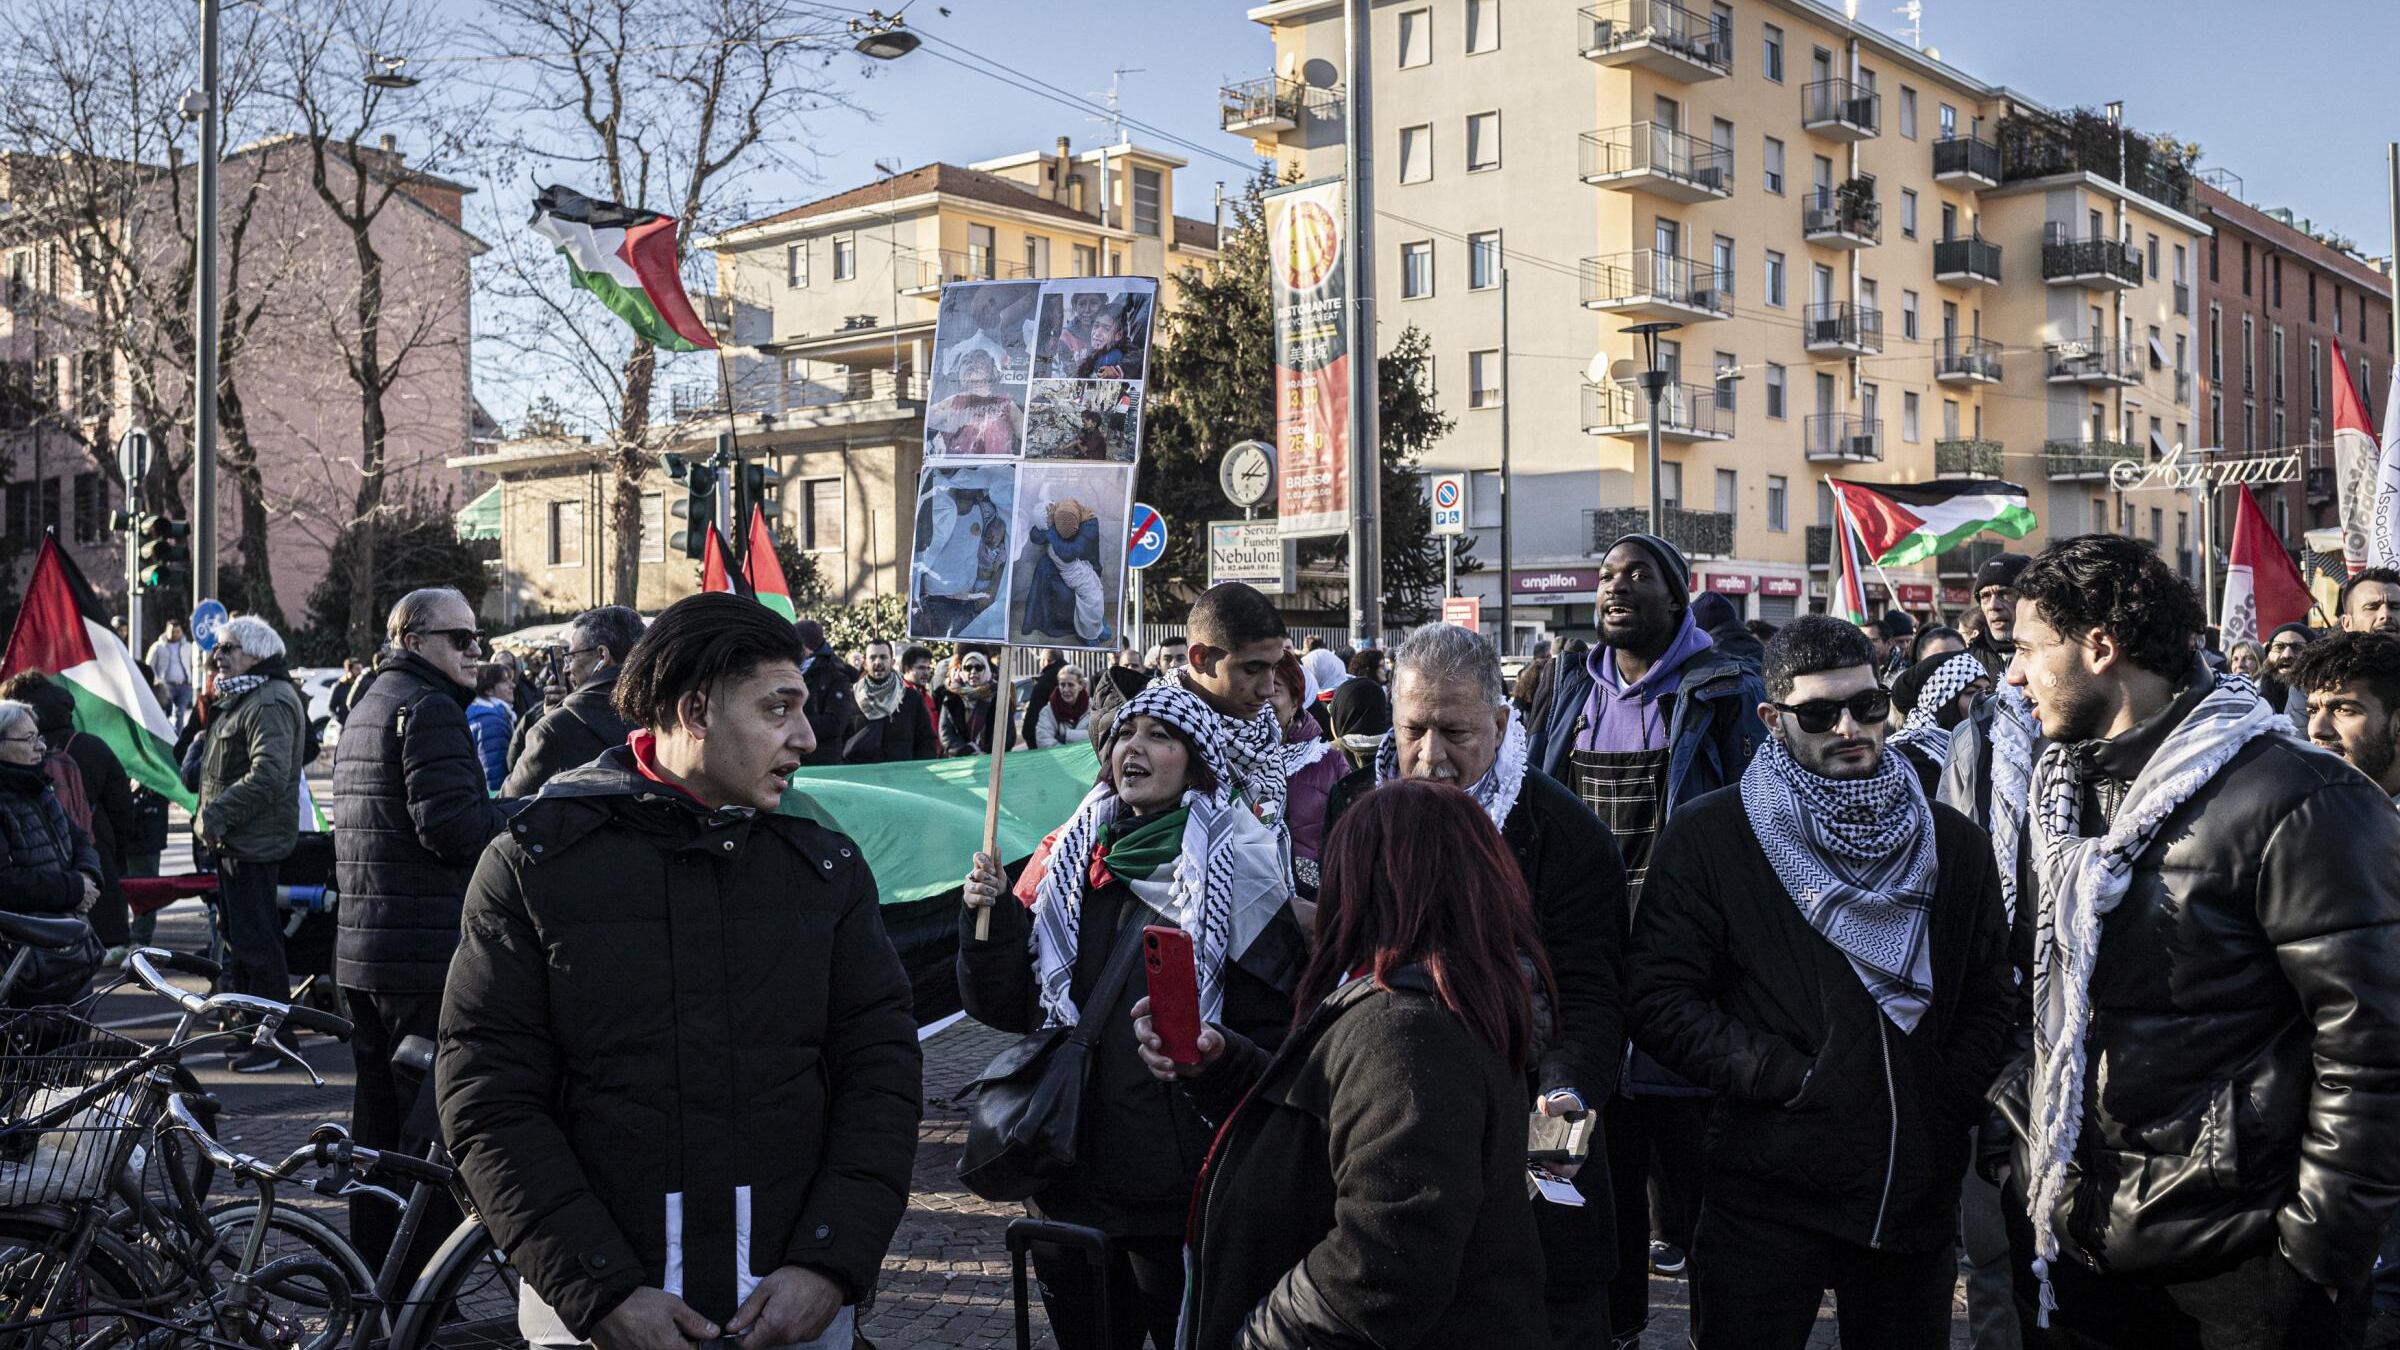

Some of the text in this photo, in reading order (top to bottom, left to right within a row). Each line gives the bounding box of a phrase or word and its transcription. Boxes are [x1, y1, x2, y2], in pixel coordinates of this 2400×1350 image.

[1286, 472, 1330, 489] BRESSO
[1245, 527, 1277, 535] Servizi
[1243, 537, 1279, 547] Funebri
[1214, 547, 1280, 563] Nebuloni
[1521, 574, 1577, 590] amplifon
[1715, 576, 1746, 591] amplifon
[1768, 579, 1797, 593] amplifon
[1533, 594, 1565, 603] amplifon
